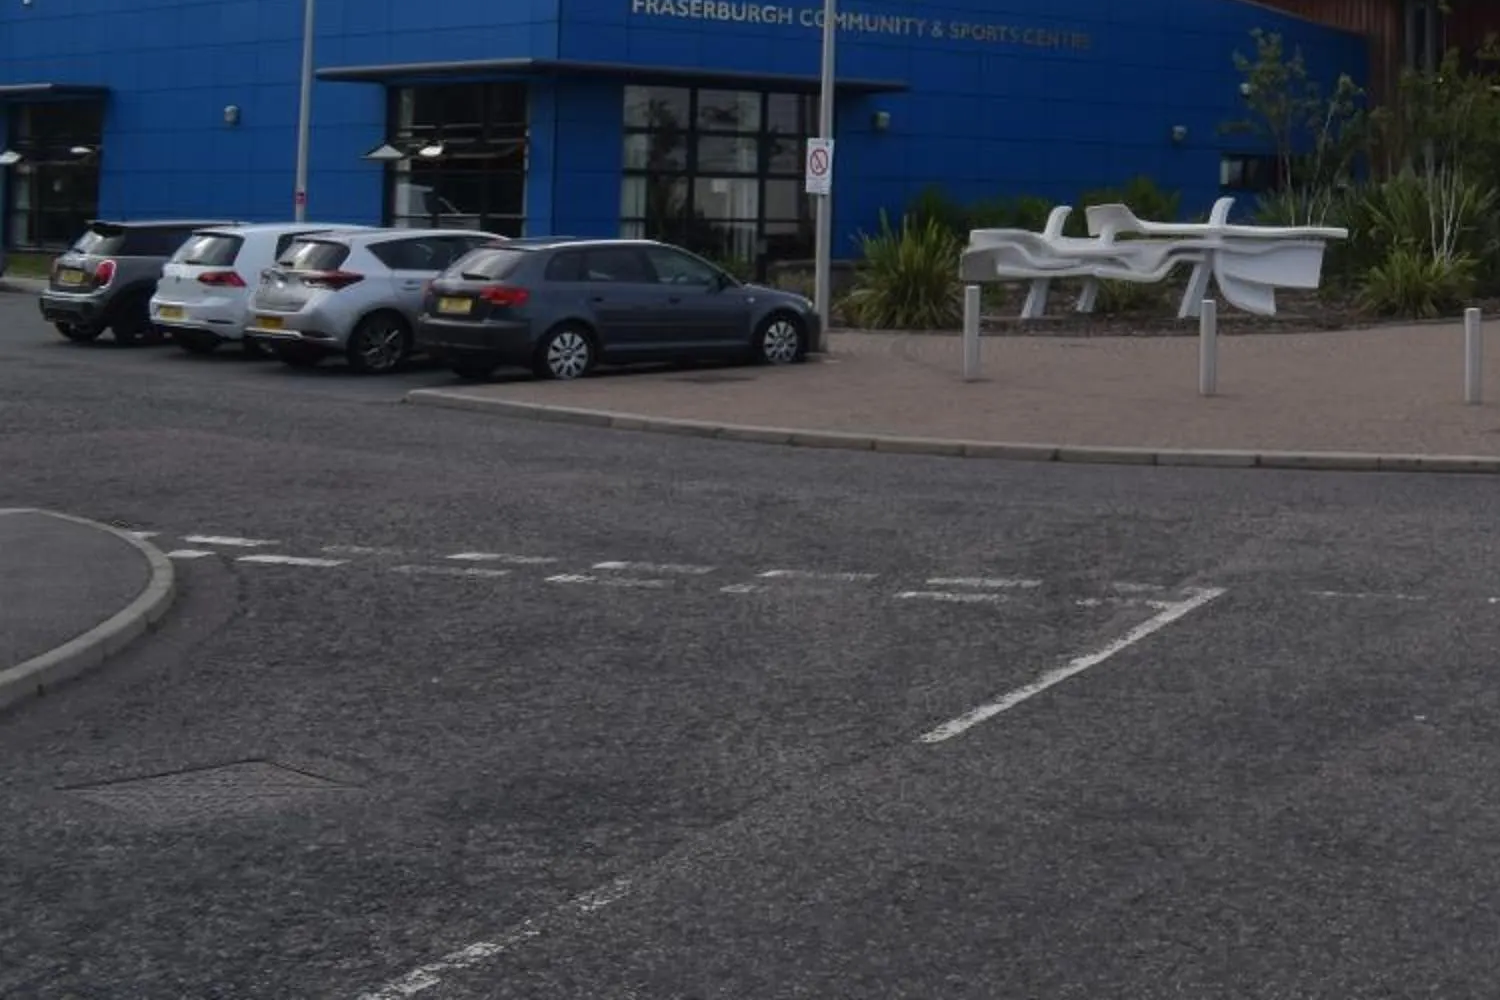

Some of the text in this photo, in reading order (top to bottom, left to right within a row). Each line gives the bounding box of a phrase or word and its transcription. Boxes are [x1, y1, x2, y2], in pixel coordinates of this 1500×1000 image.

[799, 8, 926, 38] COMMUNITY
[930, 20, 944, 38] &
[948, 20, 1021, 43] SPORTS
